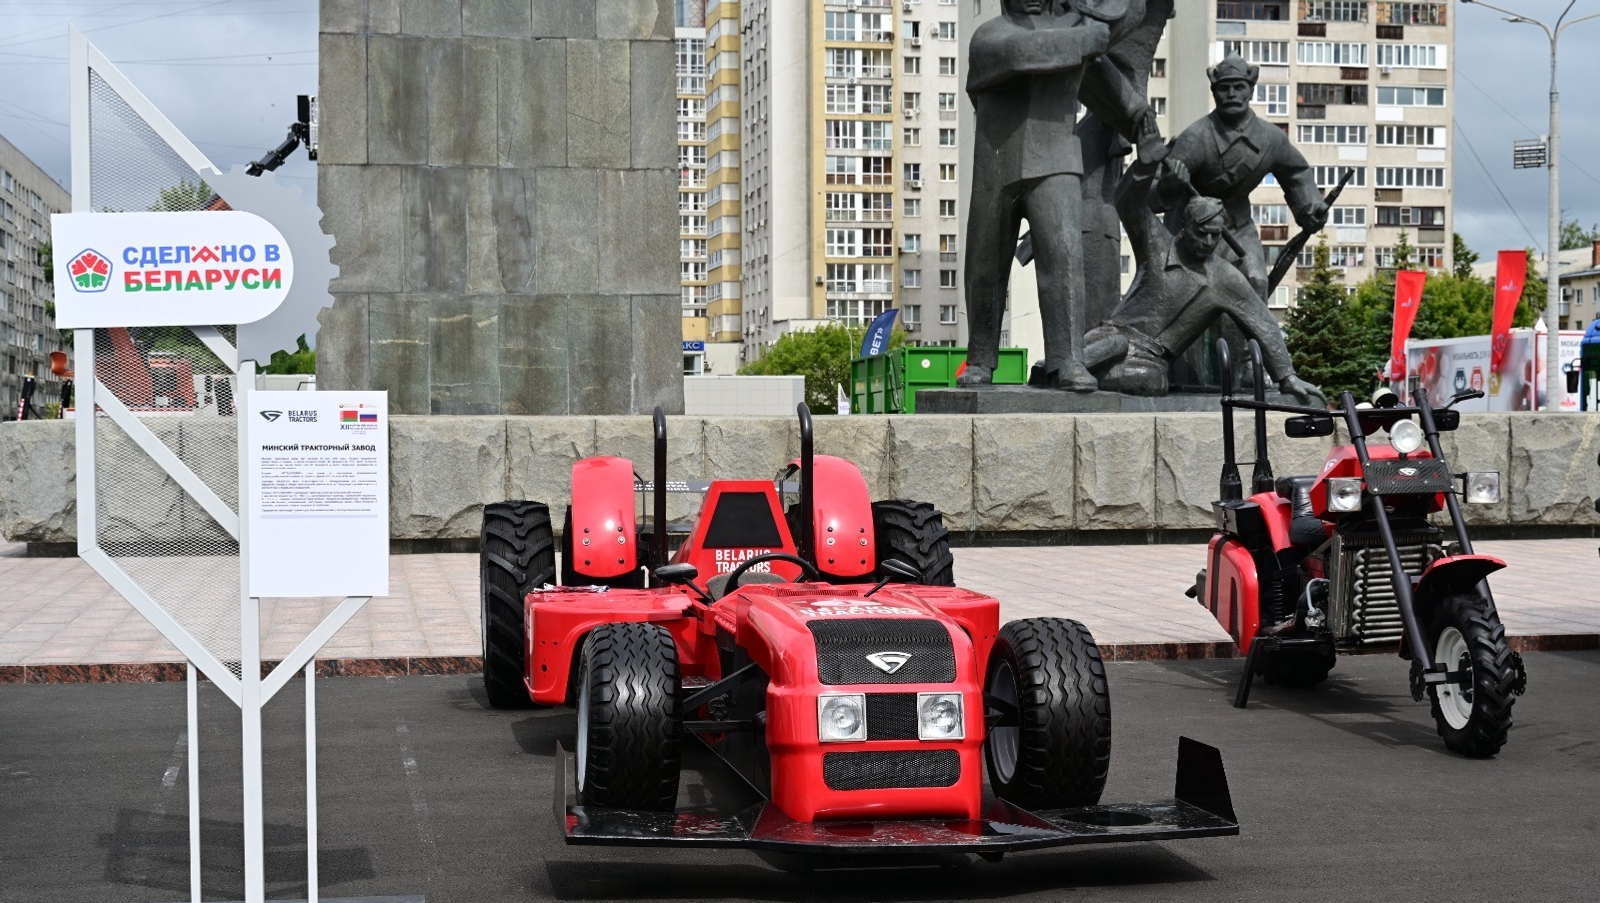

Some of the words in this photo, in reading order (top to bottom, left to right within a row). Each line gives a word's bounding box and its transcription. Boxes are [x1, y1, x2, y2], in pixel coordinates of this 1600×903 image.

[265, 244, 281, 262] В
[124, 268, 282, 293] БЕЛАРУСИ
[262, 443, 299, 452] МИНСКИЙ
[301, 443, 350, 452] ТРАКТОРНЫЙ
[351, 444, 376, 452] ЗАВОД
[715, 561, 771, 573] TRAORS
